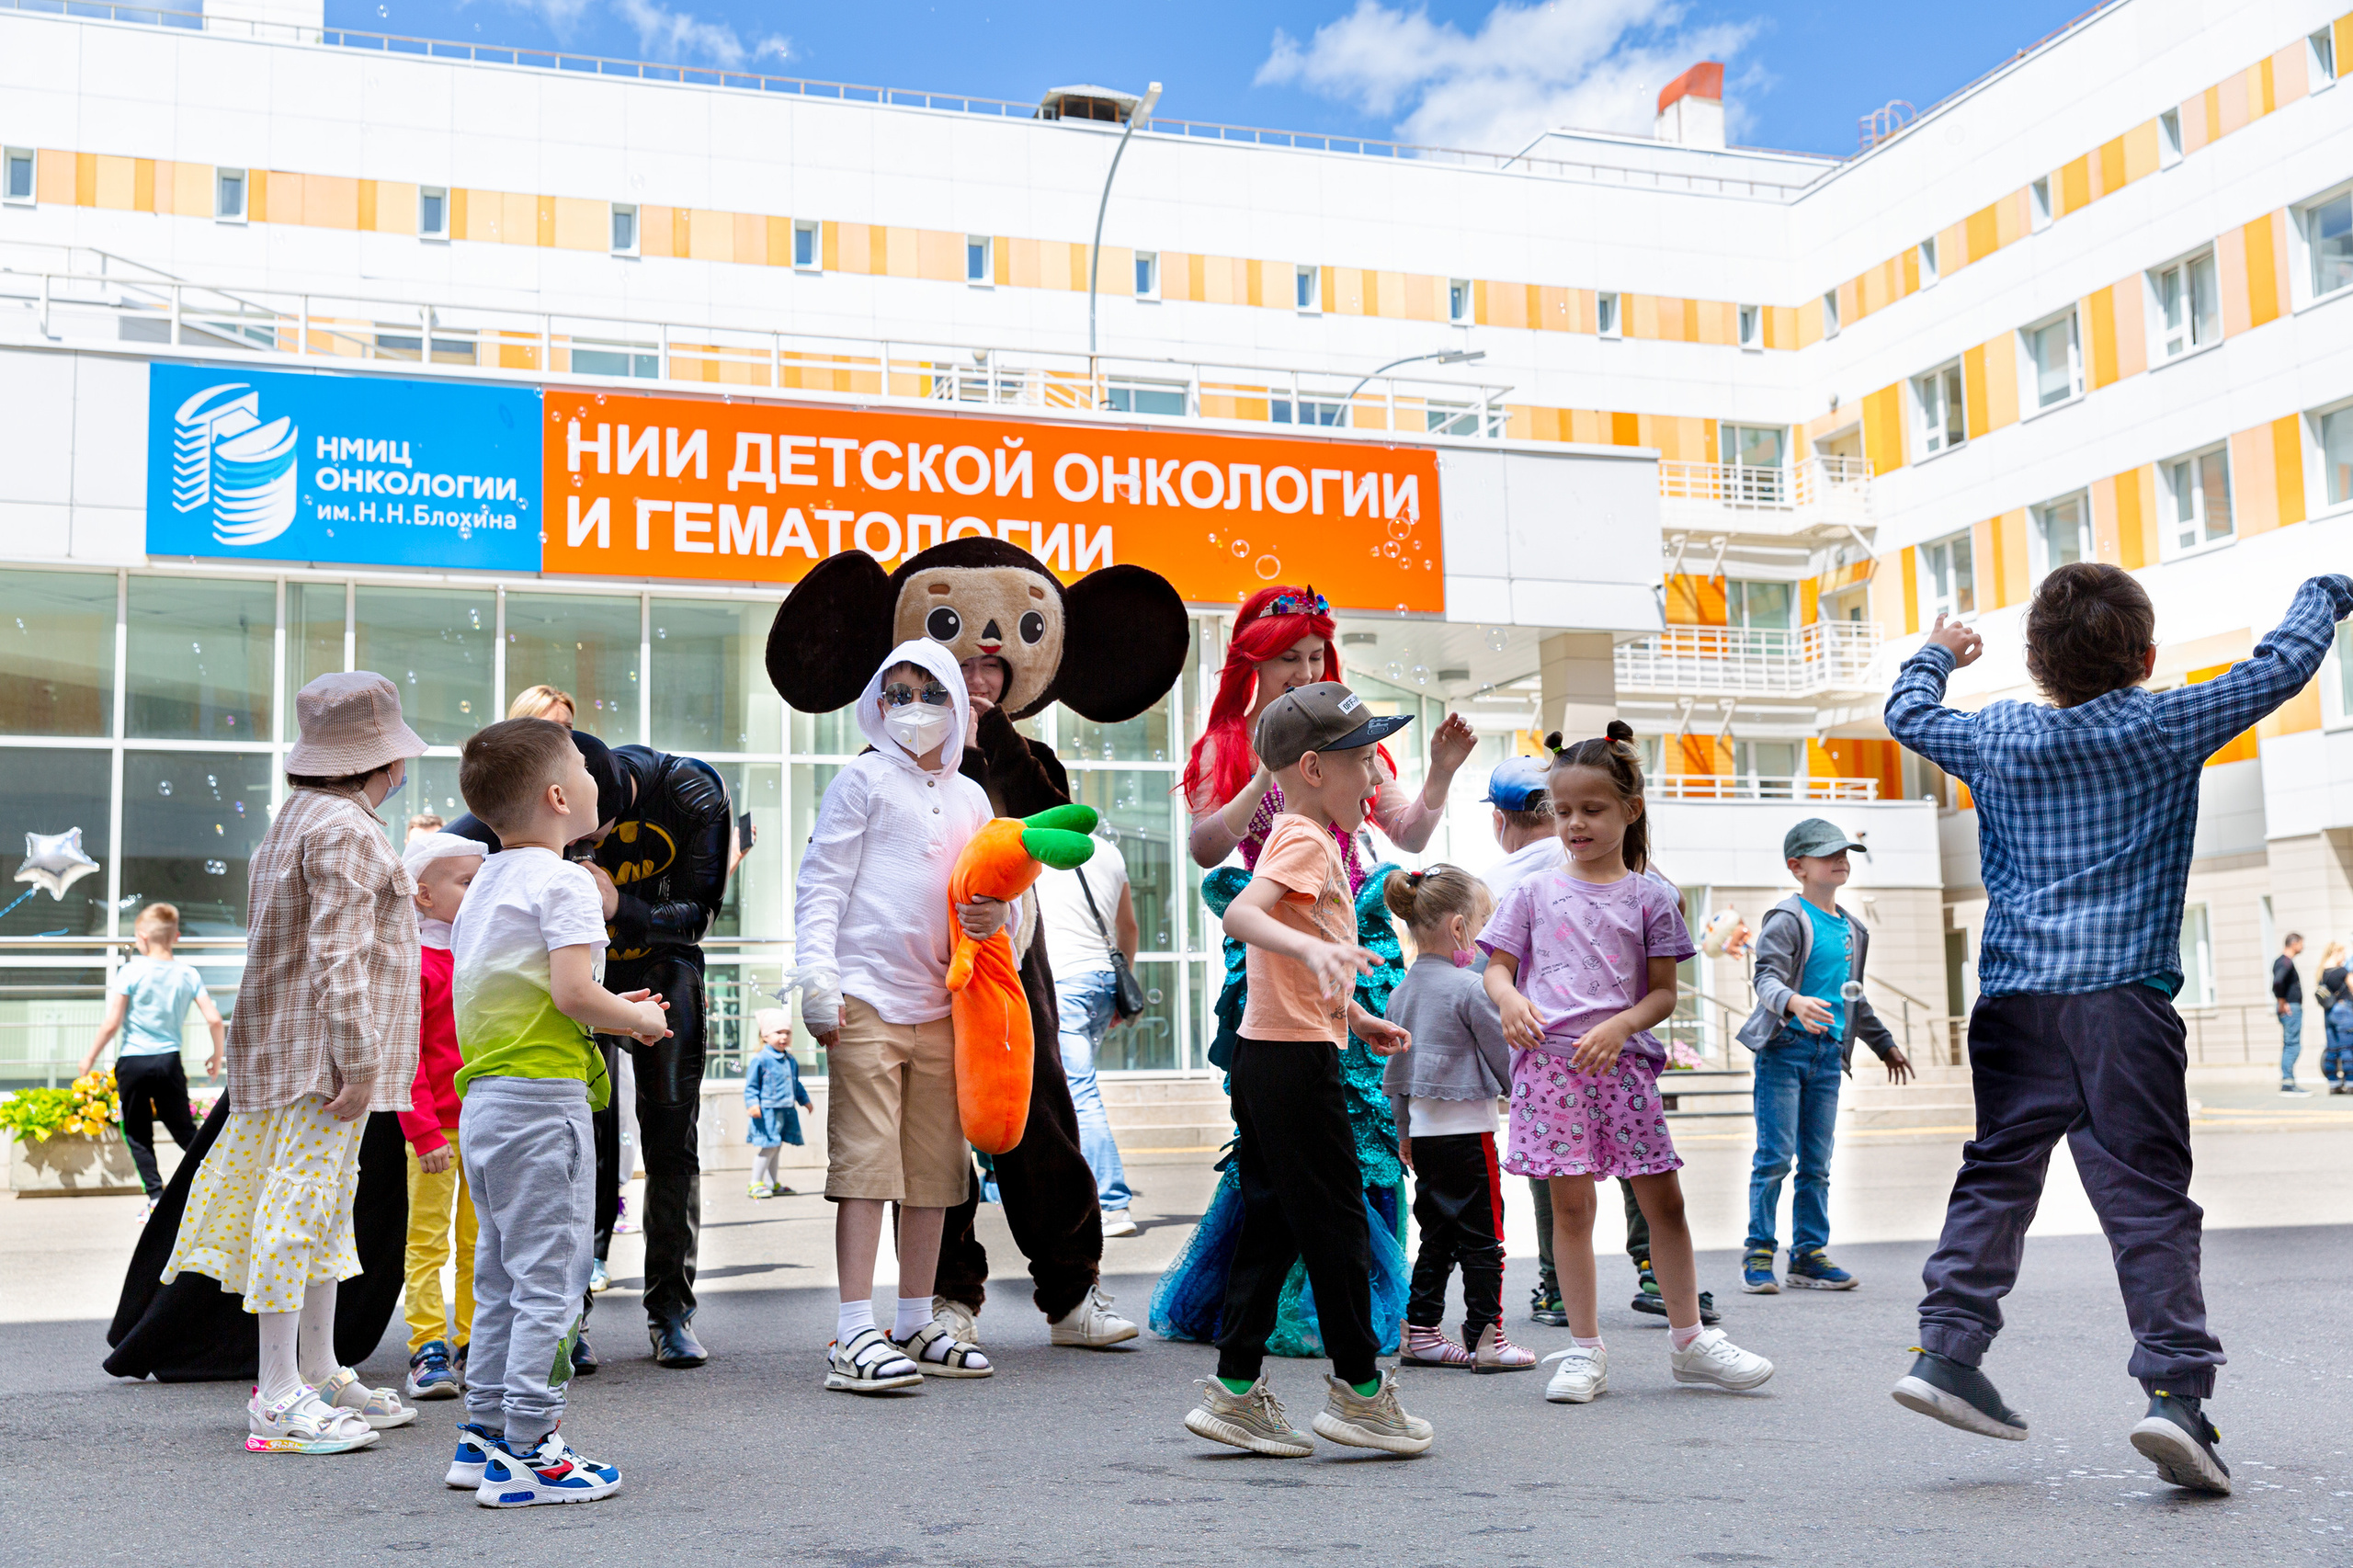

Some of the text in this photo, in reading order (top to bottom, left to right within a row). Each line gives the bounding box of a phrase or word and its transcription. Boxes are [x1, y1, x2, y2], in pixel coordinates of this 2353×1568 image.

[317, 436, 413, 469] НМИЦ
[567, 421, 1419, 520] НИИ ДЕТСКОЙ ОНКОЛОГИИ
[315, 467, 517, 501] ОНКОЛОГИИ
[567, 495, 610, 549] И
